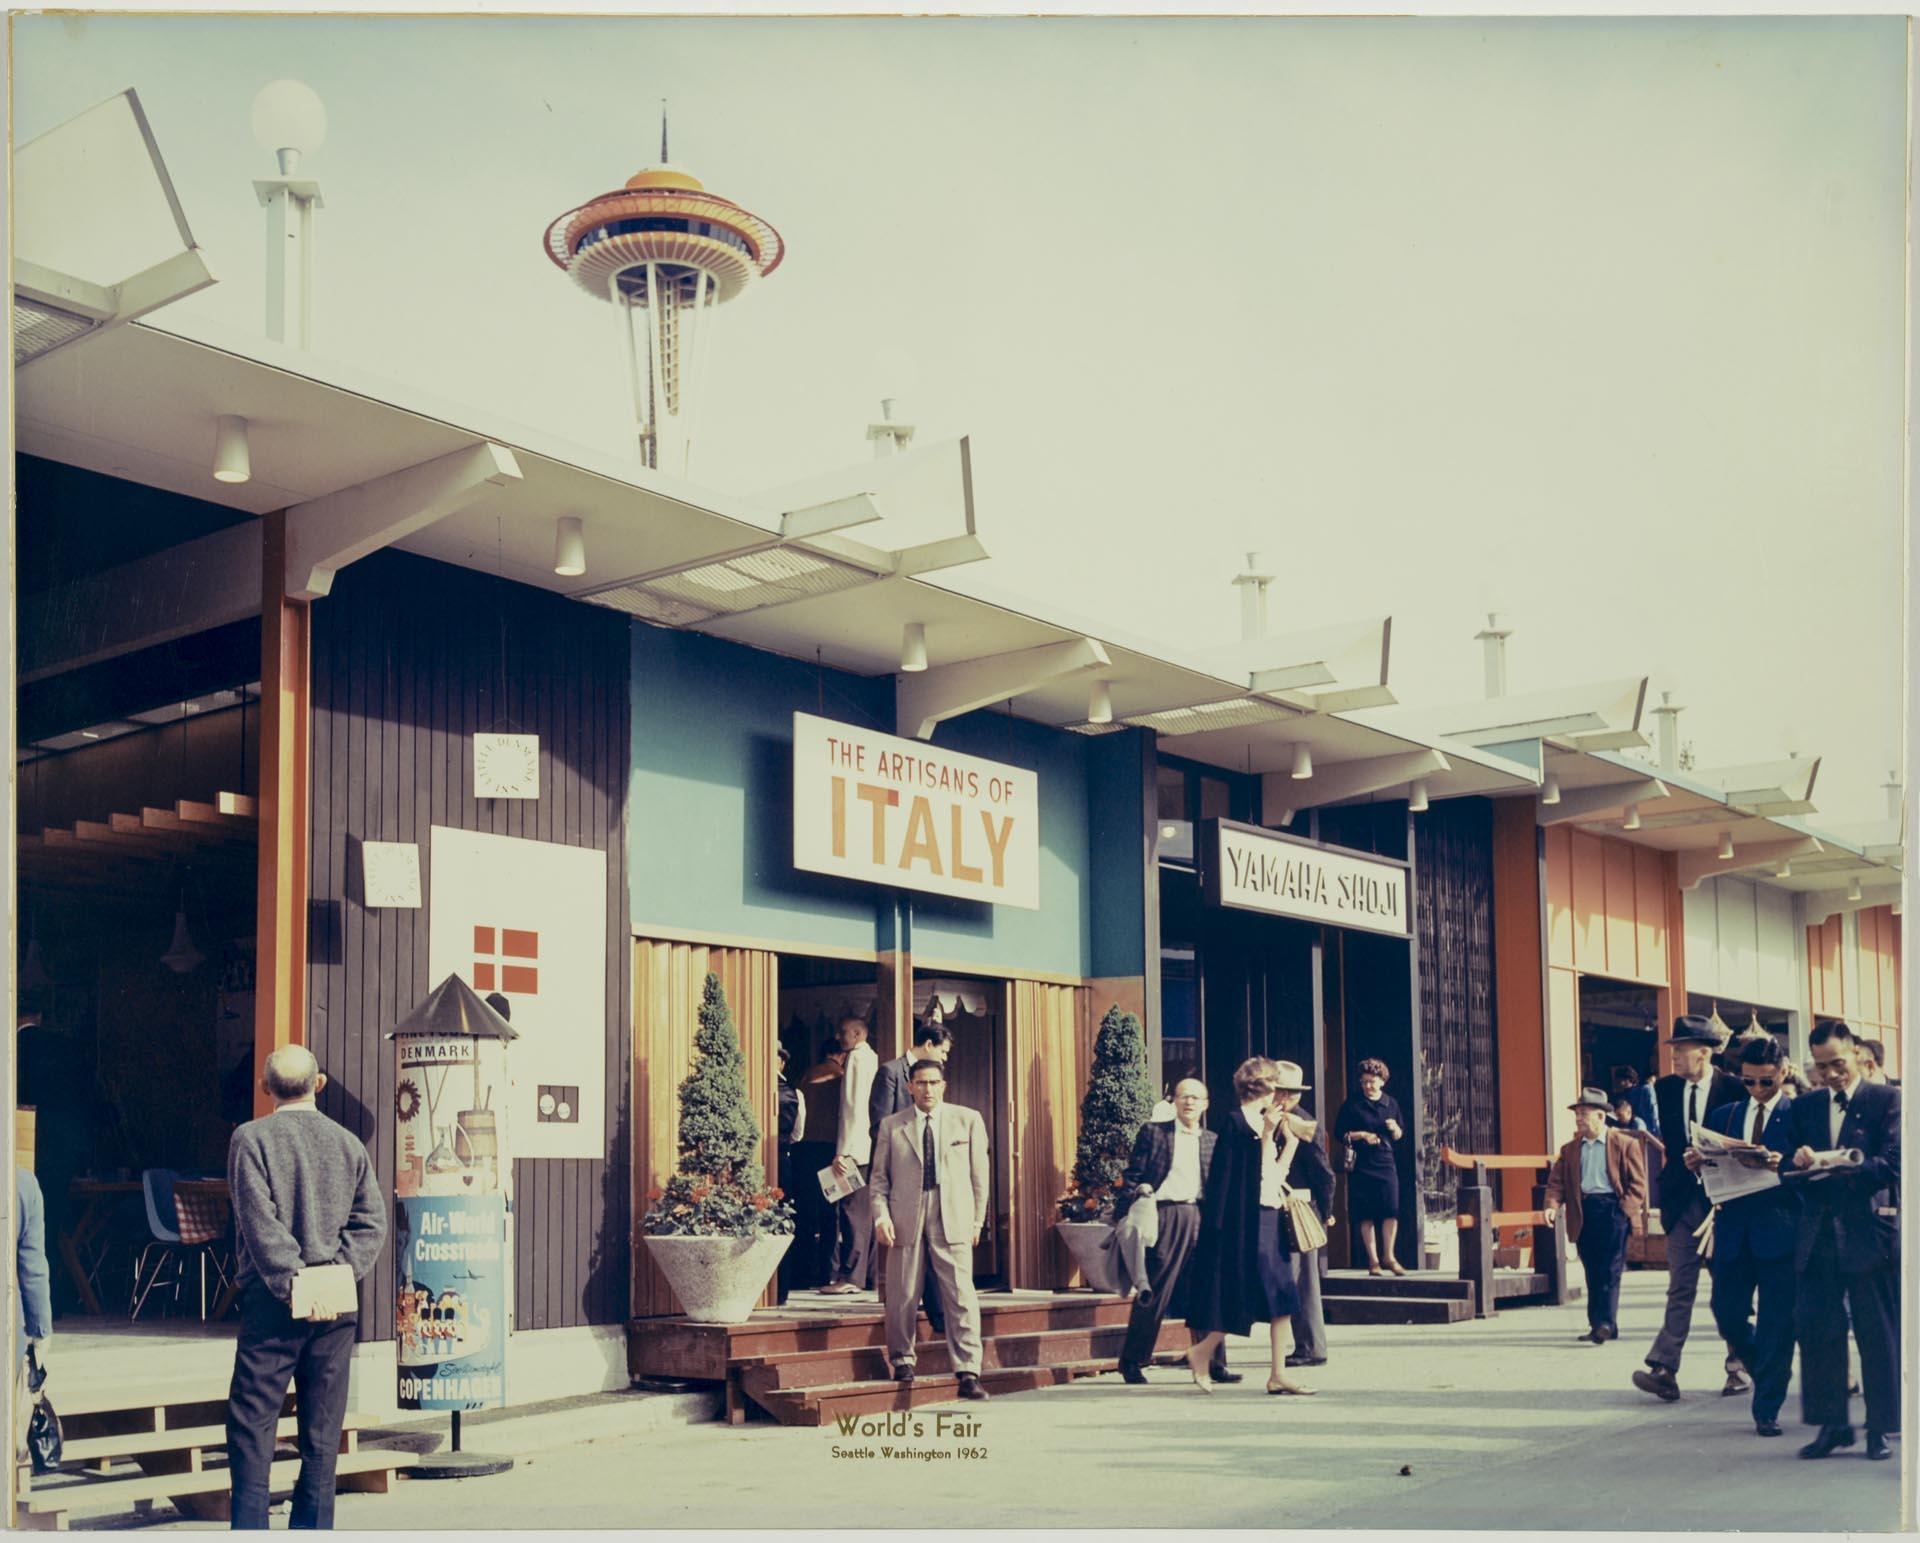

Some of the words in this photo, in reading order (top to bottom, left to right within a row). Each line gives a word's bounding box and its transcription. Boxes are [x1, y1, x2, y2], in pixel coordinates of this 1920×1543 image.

[827, 737, 865, 772] THE
[878, 751, 979, 799] ARTISANS
[989, 778, 1014, 805] OF
[831, 775, 1015, 888] ITALY
[1227, 846, 1328, 905] YAMAHA
[1337, 873, 1397, 917] SHOJI
[401, 1045, 469, 1059] DENMARK
[415, 1238, 500, 1262] Crossro
